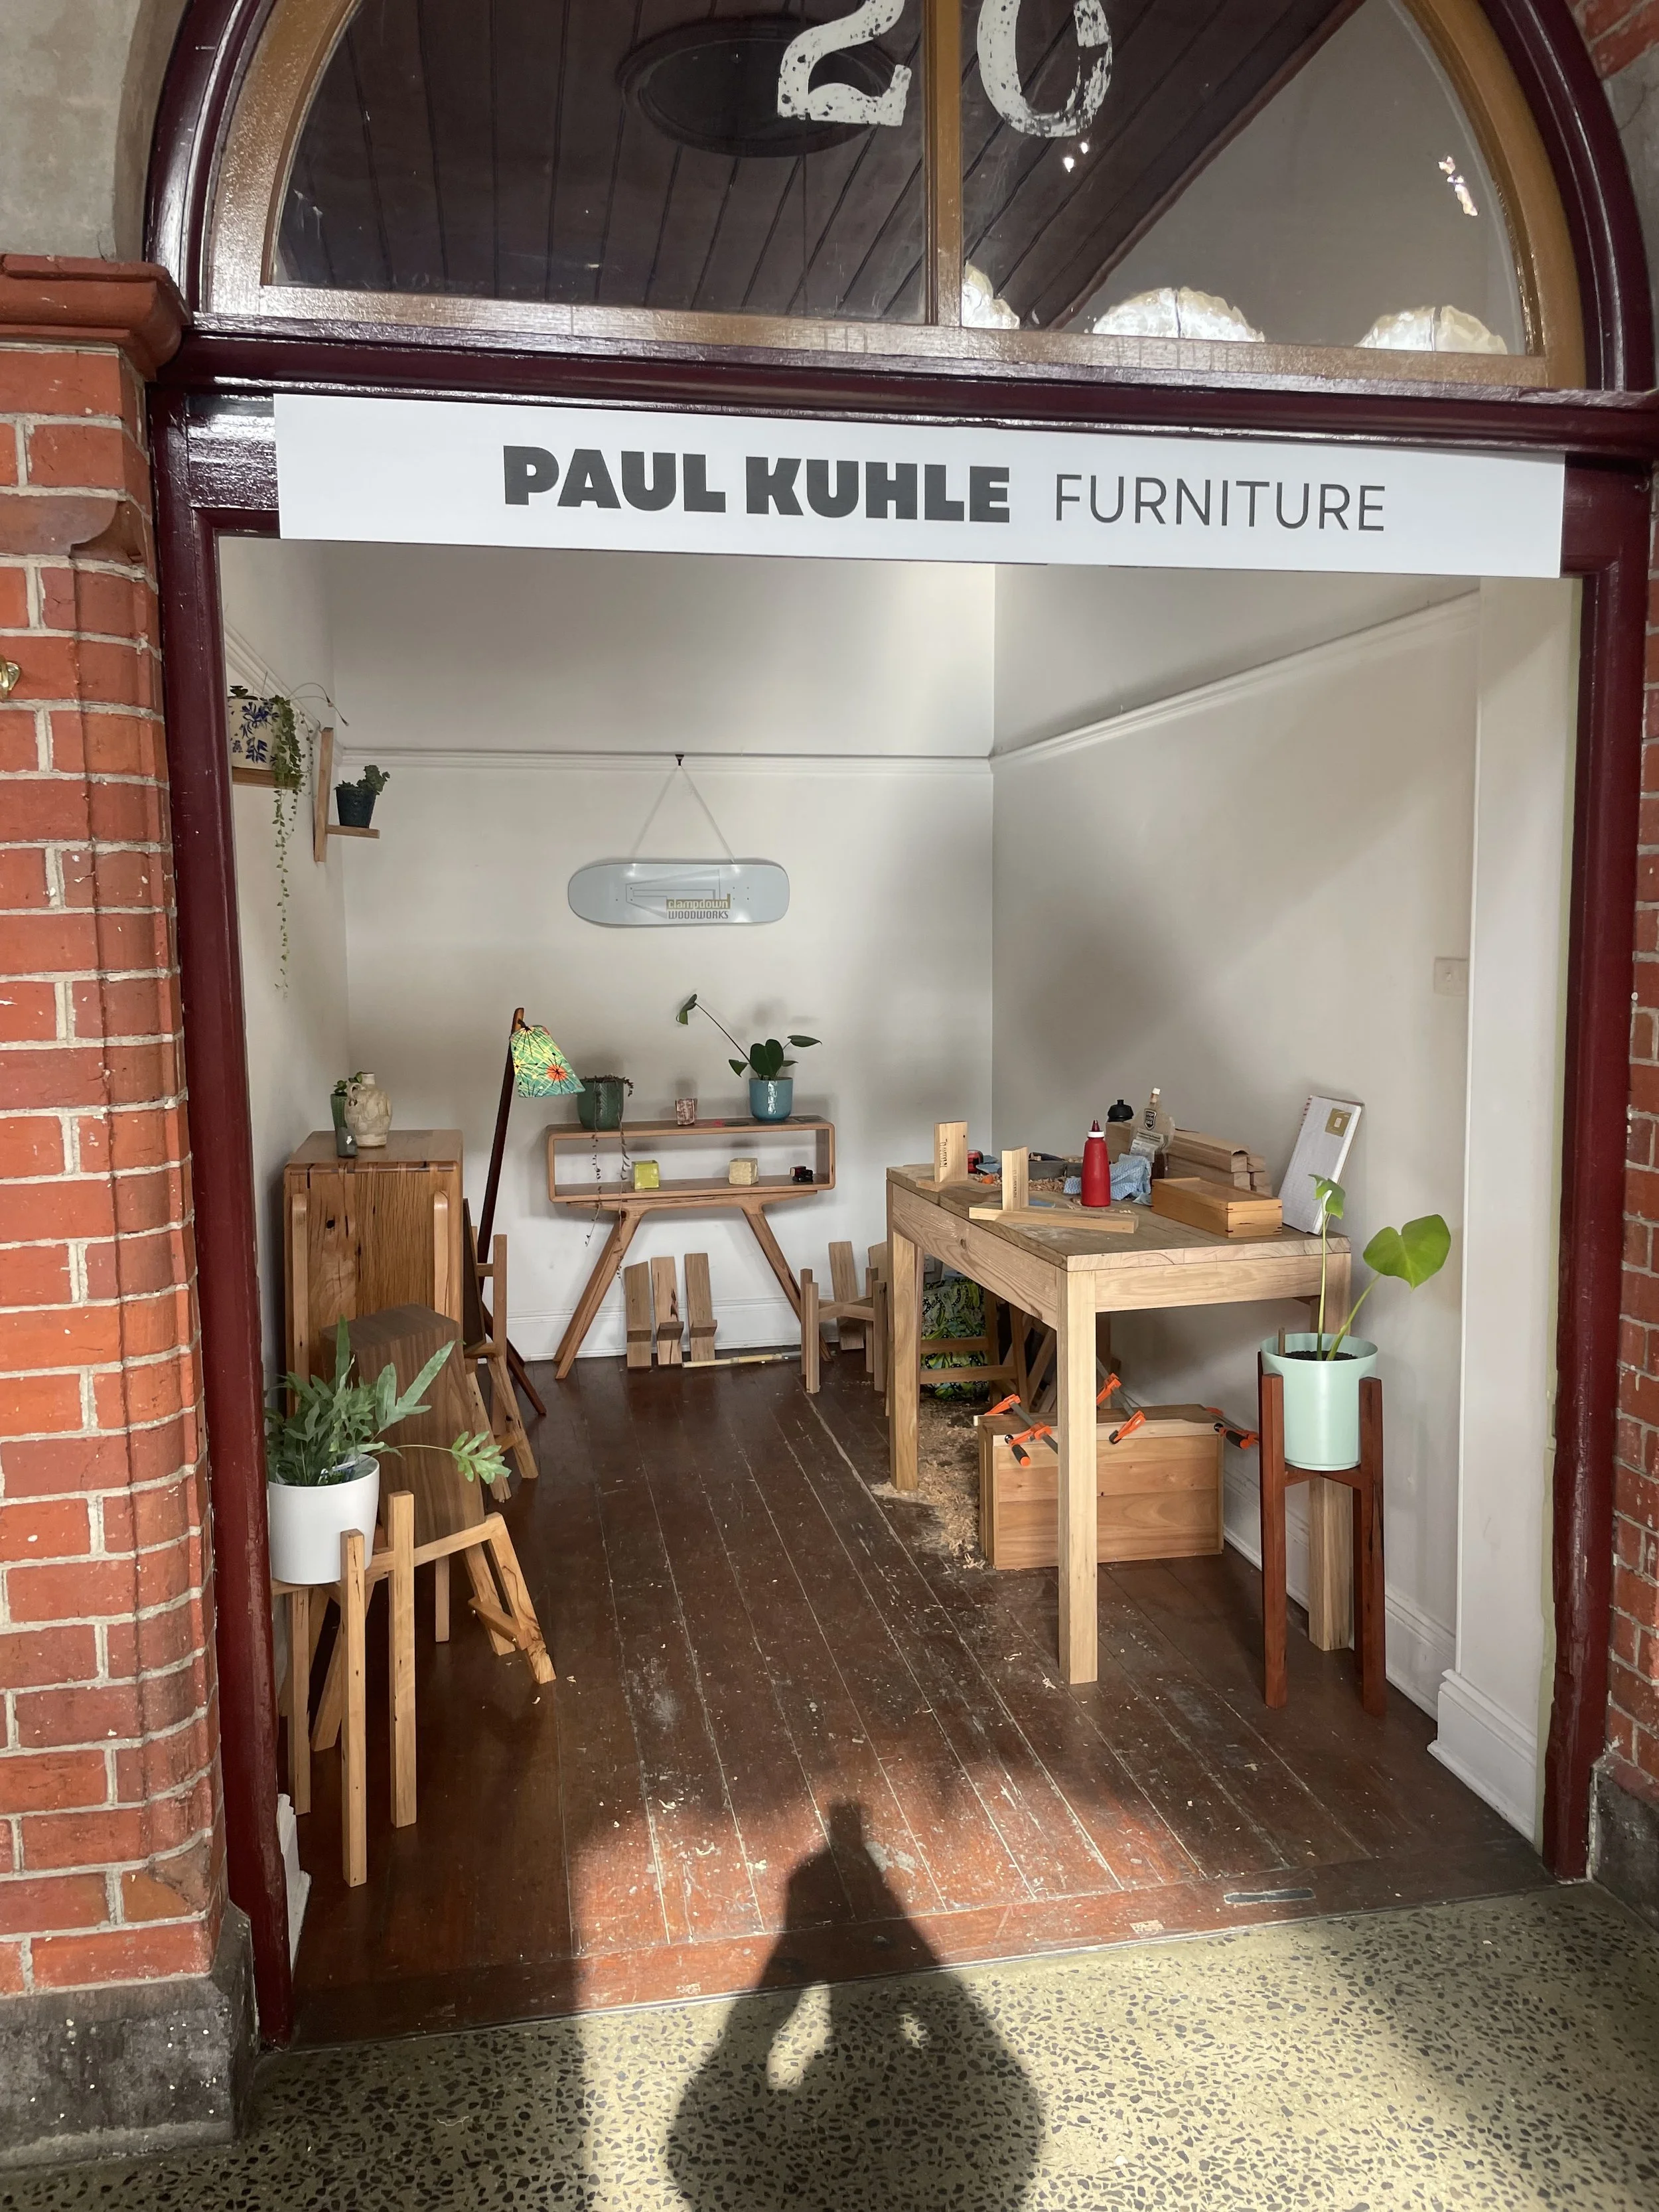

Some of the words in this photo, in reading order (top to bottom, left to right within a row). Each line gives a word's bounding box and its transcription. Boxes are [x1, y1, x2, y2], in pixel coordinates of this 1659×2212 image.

[503, 445, 726, 513] PAUL
[745, 456, 1010, 523] KUHLE
[1055, 474, 1386, 532] FURNITURE
[668, 898, 729, 909] clampdown
[668, 911, 729, 919] WOODWORKS
